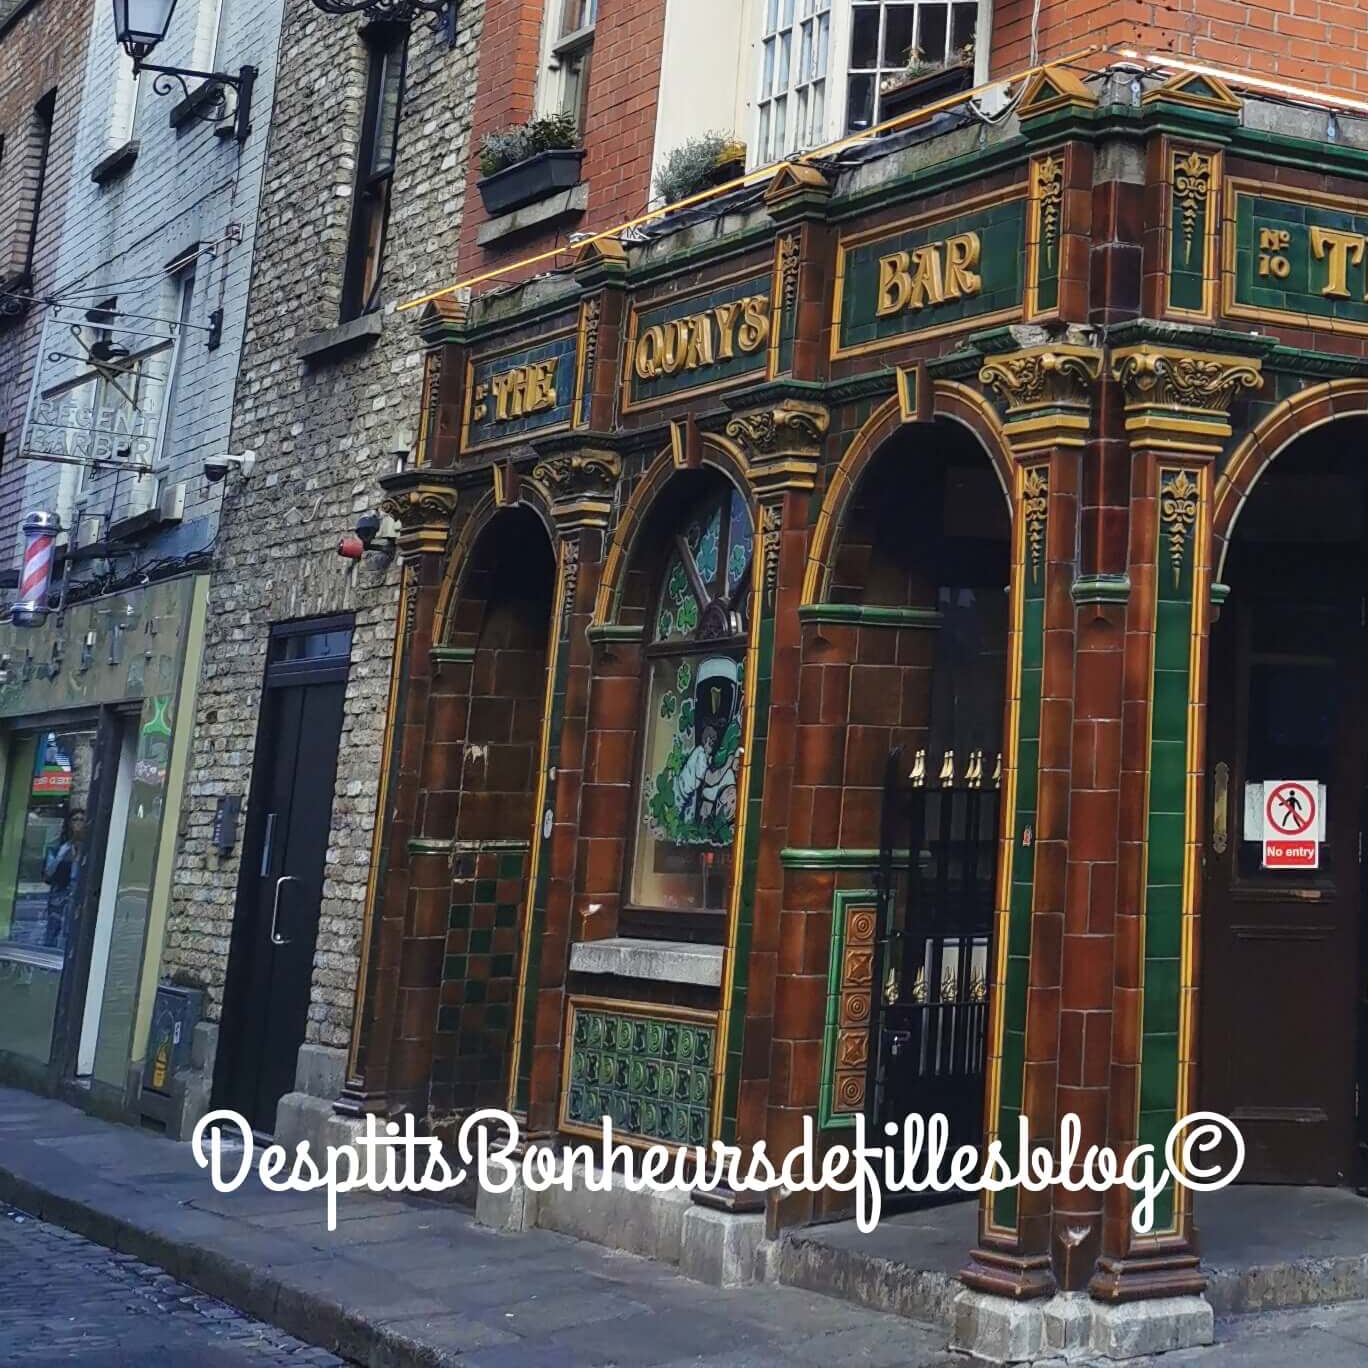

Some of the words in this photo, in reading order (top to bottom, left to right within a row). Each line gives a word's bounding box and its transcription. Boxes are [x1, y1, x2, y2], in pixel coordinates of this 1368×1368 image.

[1259, 254, 1290, 278] 10
[492, 356, 558, 421] THE
[875, 231, 982, 317] BAR
[1267, 846, 1283, 857] No
[1285, 846, 1315, 860] entry
